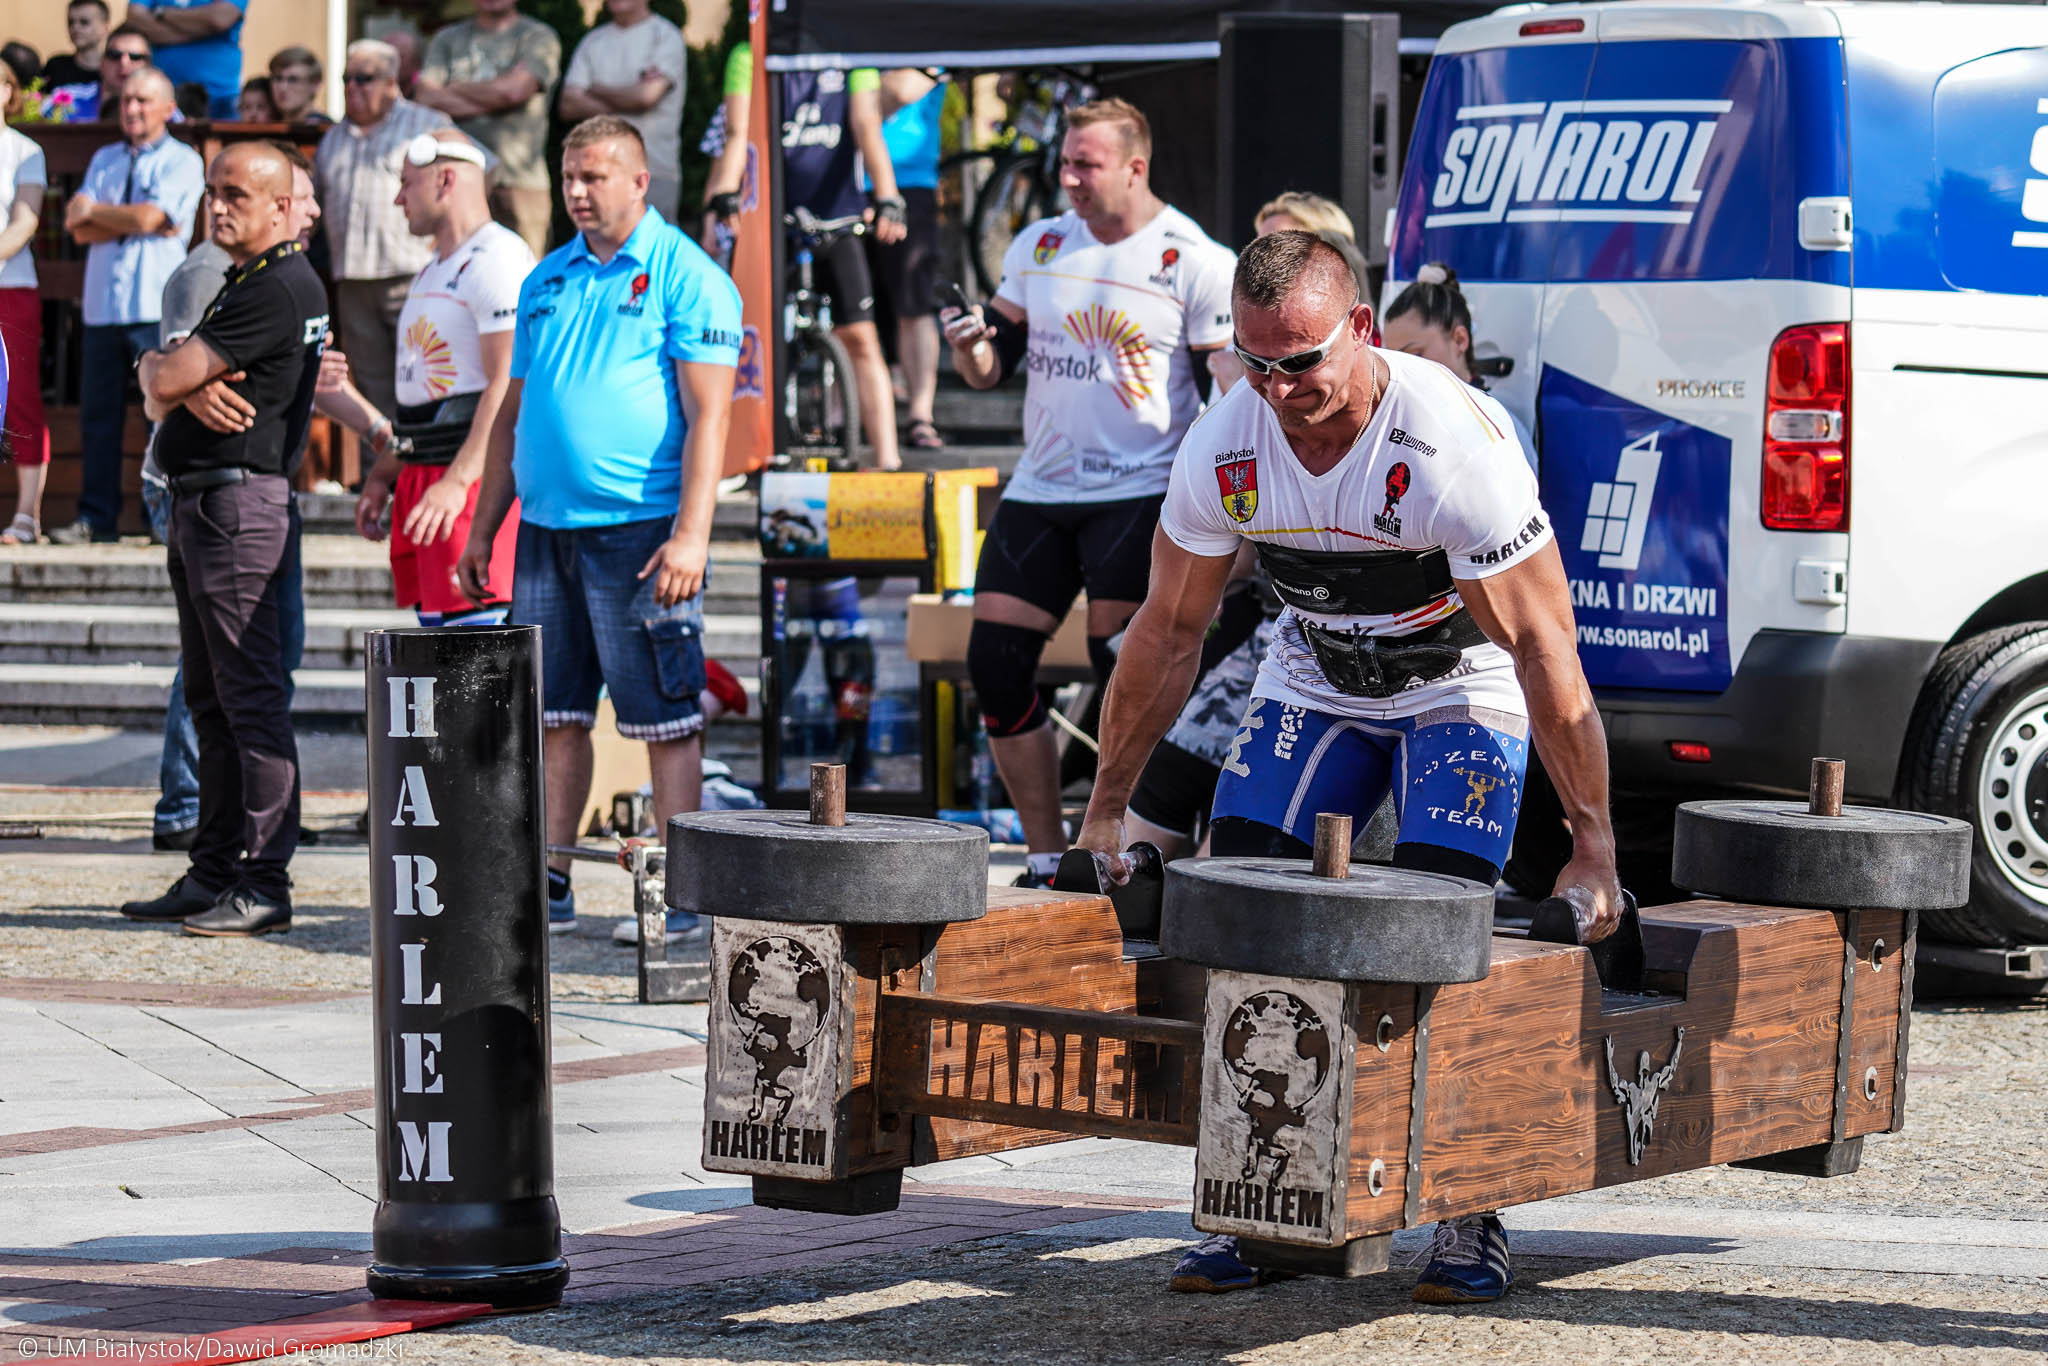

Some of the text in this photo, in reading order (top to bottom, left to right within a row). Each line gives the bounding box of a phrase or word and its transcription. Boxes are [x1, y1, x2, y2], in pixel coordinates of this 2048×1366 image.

[1430, 104, 1724, 222] SONAROL
[1656, 380, 1746, 398] PROACE
[1568, 579, 1716, 616] KNA I DRZWI
[1577, 625, 1709, 658] w.sonarol.pl
[1427, 806, 1503, 837] TEAM
[387, 676, 454, 1182] HARLEM
[927, 1018, 1185, 1124] HARLEM
[711, 1120, 826, 1166] HARLEM
[1202, 1178, 1323, 1228] HARLEM
